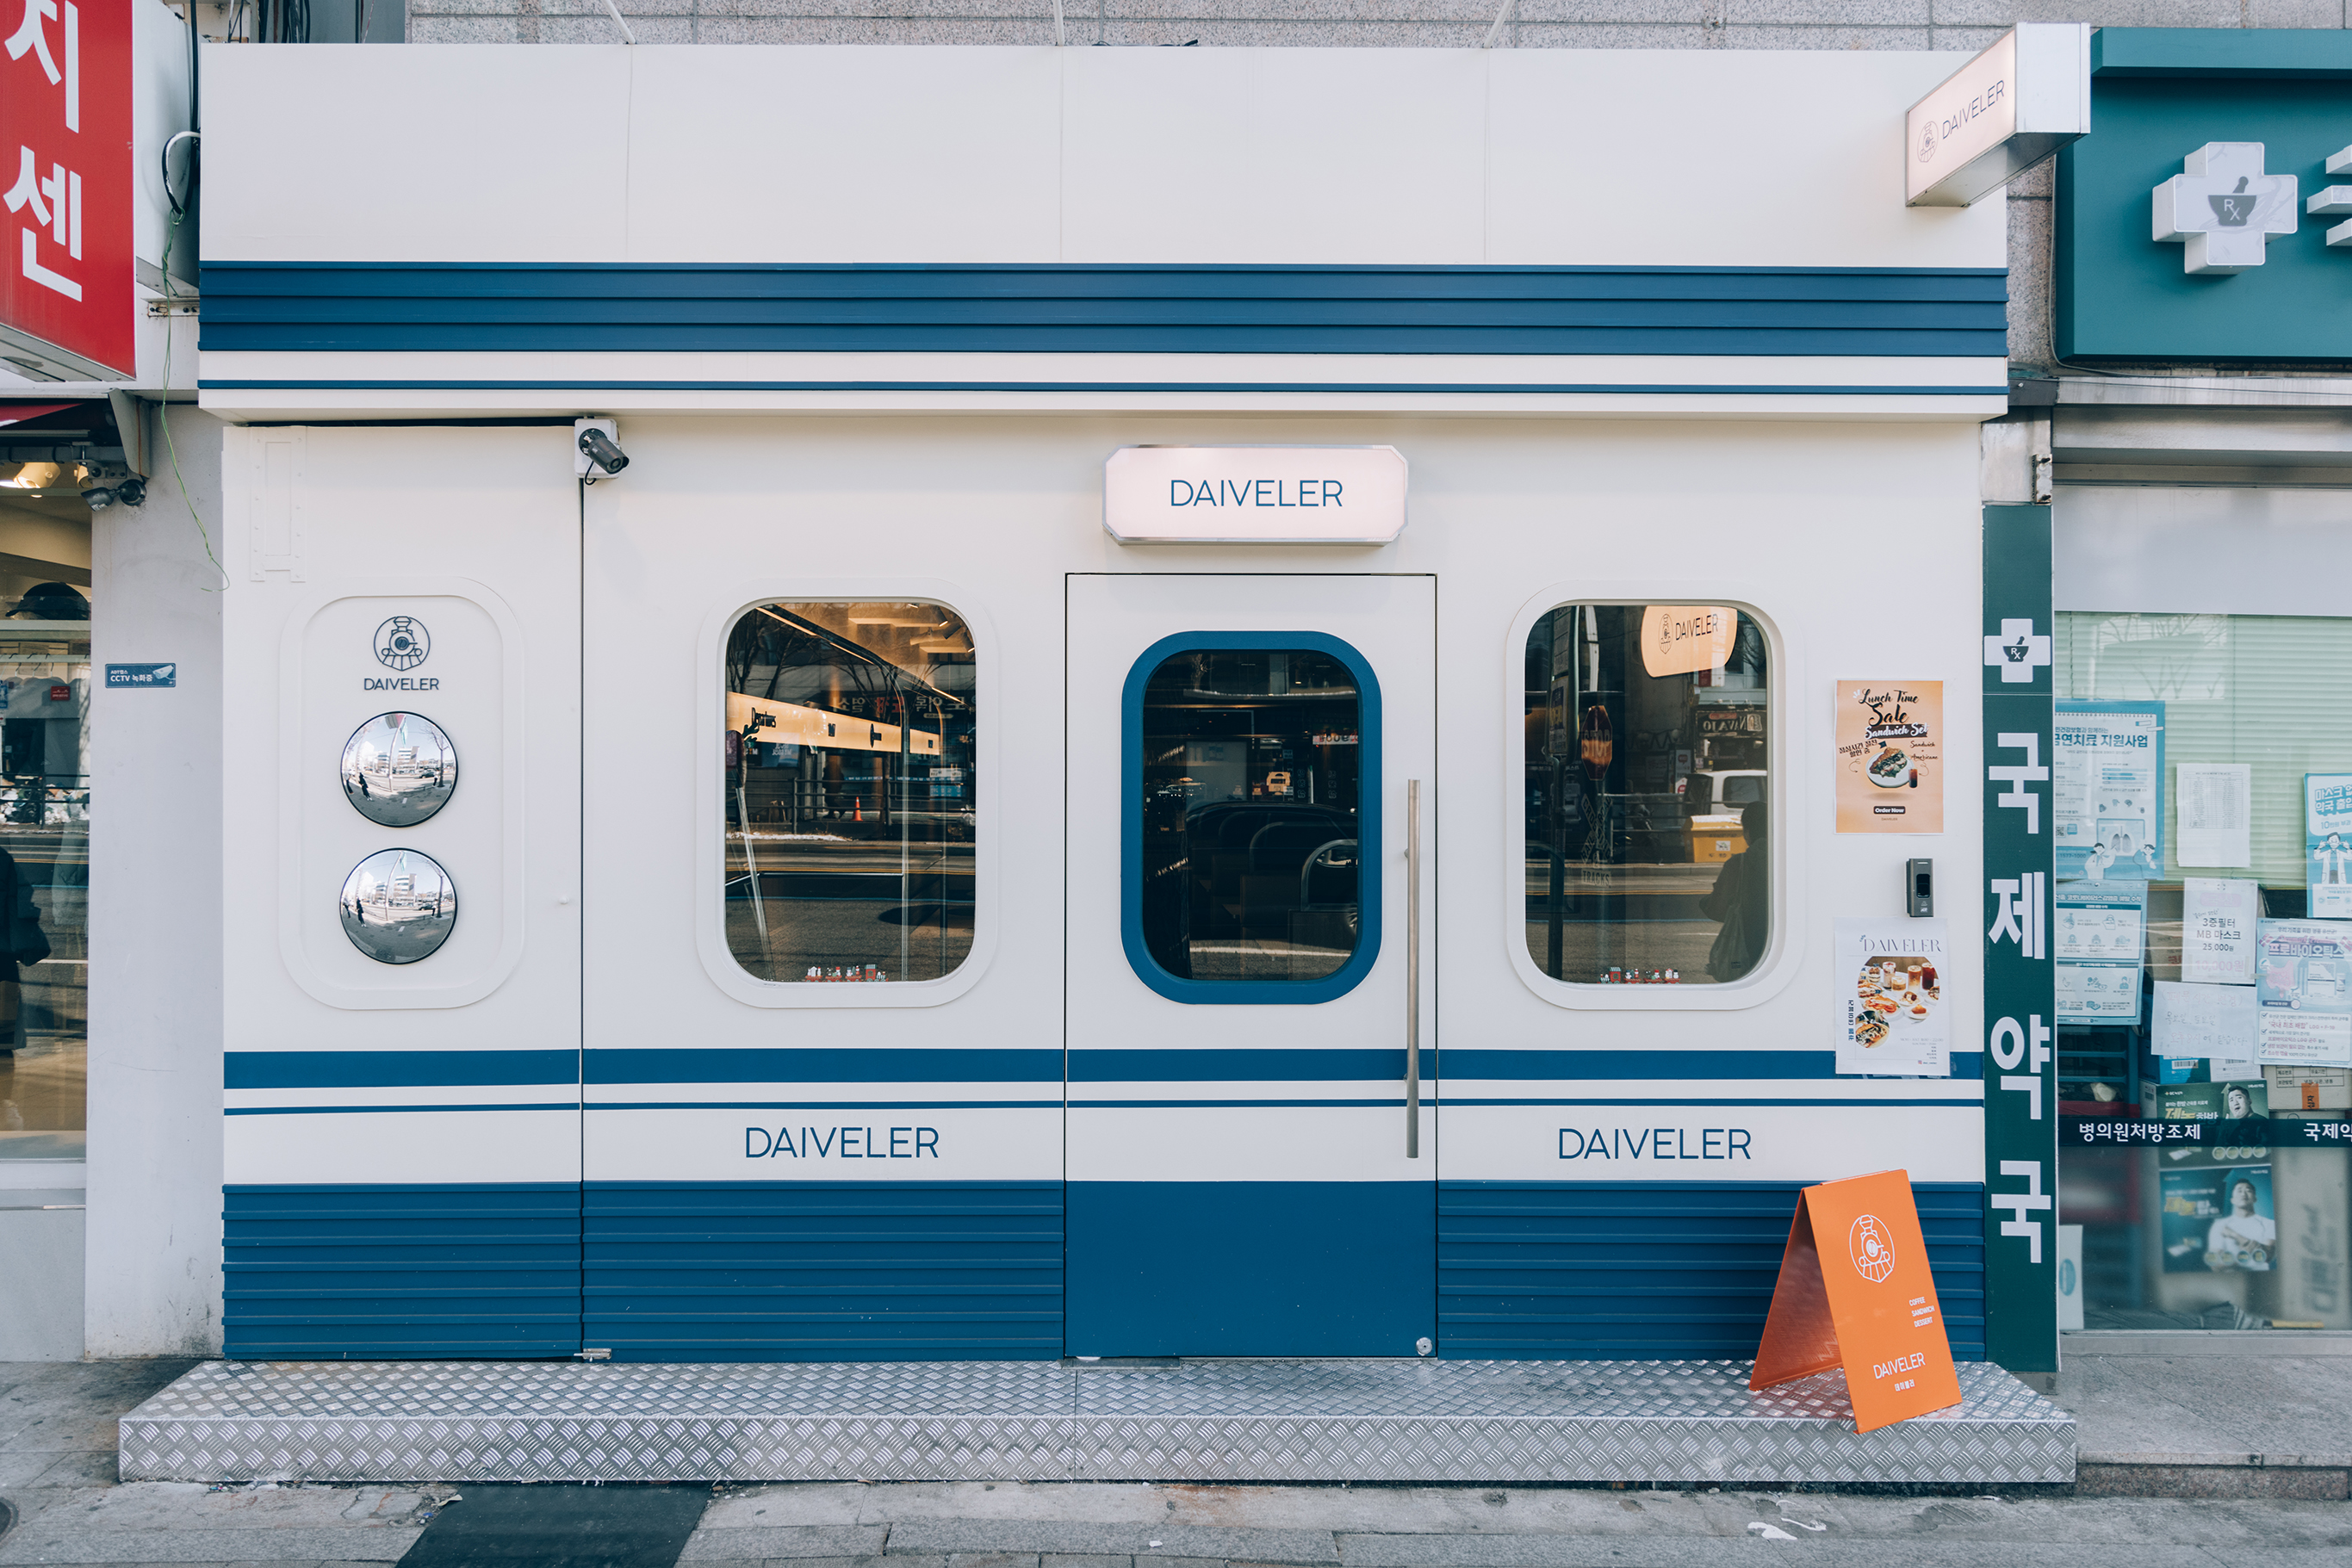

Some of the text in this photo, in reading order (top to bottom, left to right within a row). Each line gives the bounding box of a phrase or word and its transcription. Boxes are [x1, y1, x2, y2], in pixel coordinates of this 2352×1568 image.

[1941, 79, 2005, 140] DAIVELER
[1171, 480, 1343, 507] DAIVELER
[1675, 613, 1719, 641] DAIVELER
[363, 678, 439, 691] DAIVELER
[1859, 688, 1920, 708] Lunch Time
[1868, 702, 1909, 727] Sale
[1865, 722, 1931, 740] Sandwich Set
[1582, 728, 1610, 758] STOP
[2101, 734, 2148, 747] 지원사업
[2315, 786, 2343, 802] 마스크
[1582, 870, 1610, 888] TRACKS
[2202, 918, 2236, 928] 3중필터
[2197, 930, 2241, 939] MB 마스크
[1864, 939, 1942, 952] DAIVELER
[2202, 943, 2234, 952] 25,000원
[2268, 943, 2344, 958] 프로바이오틱스
[2195, 960, 2244, 972] 10,000원
[1989, 732, 2051, 1263] 국제약국
[2078, 1122, 2201, 1143] 병의원처방조제
[746, 1127, 939, 1158] DAIVELER
[1560, 1129, 1751, 1159] DAIVELER
[1908, 1296, 1926, 1306] COFFEE
[1911, 1305, 1935, 1317] SANDWICH
[1914, 1317, 1933, 1328] DESSERT
[1872, 1352, 1926, 1379] DAIVELER
